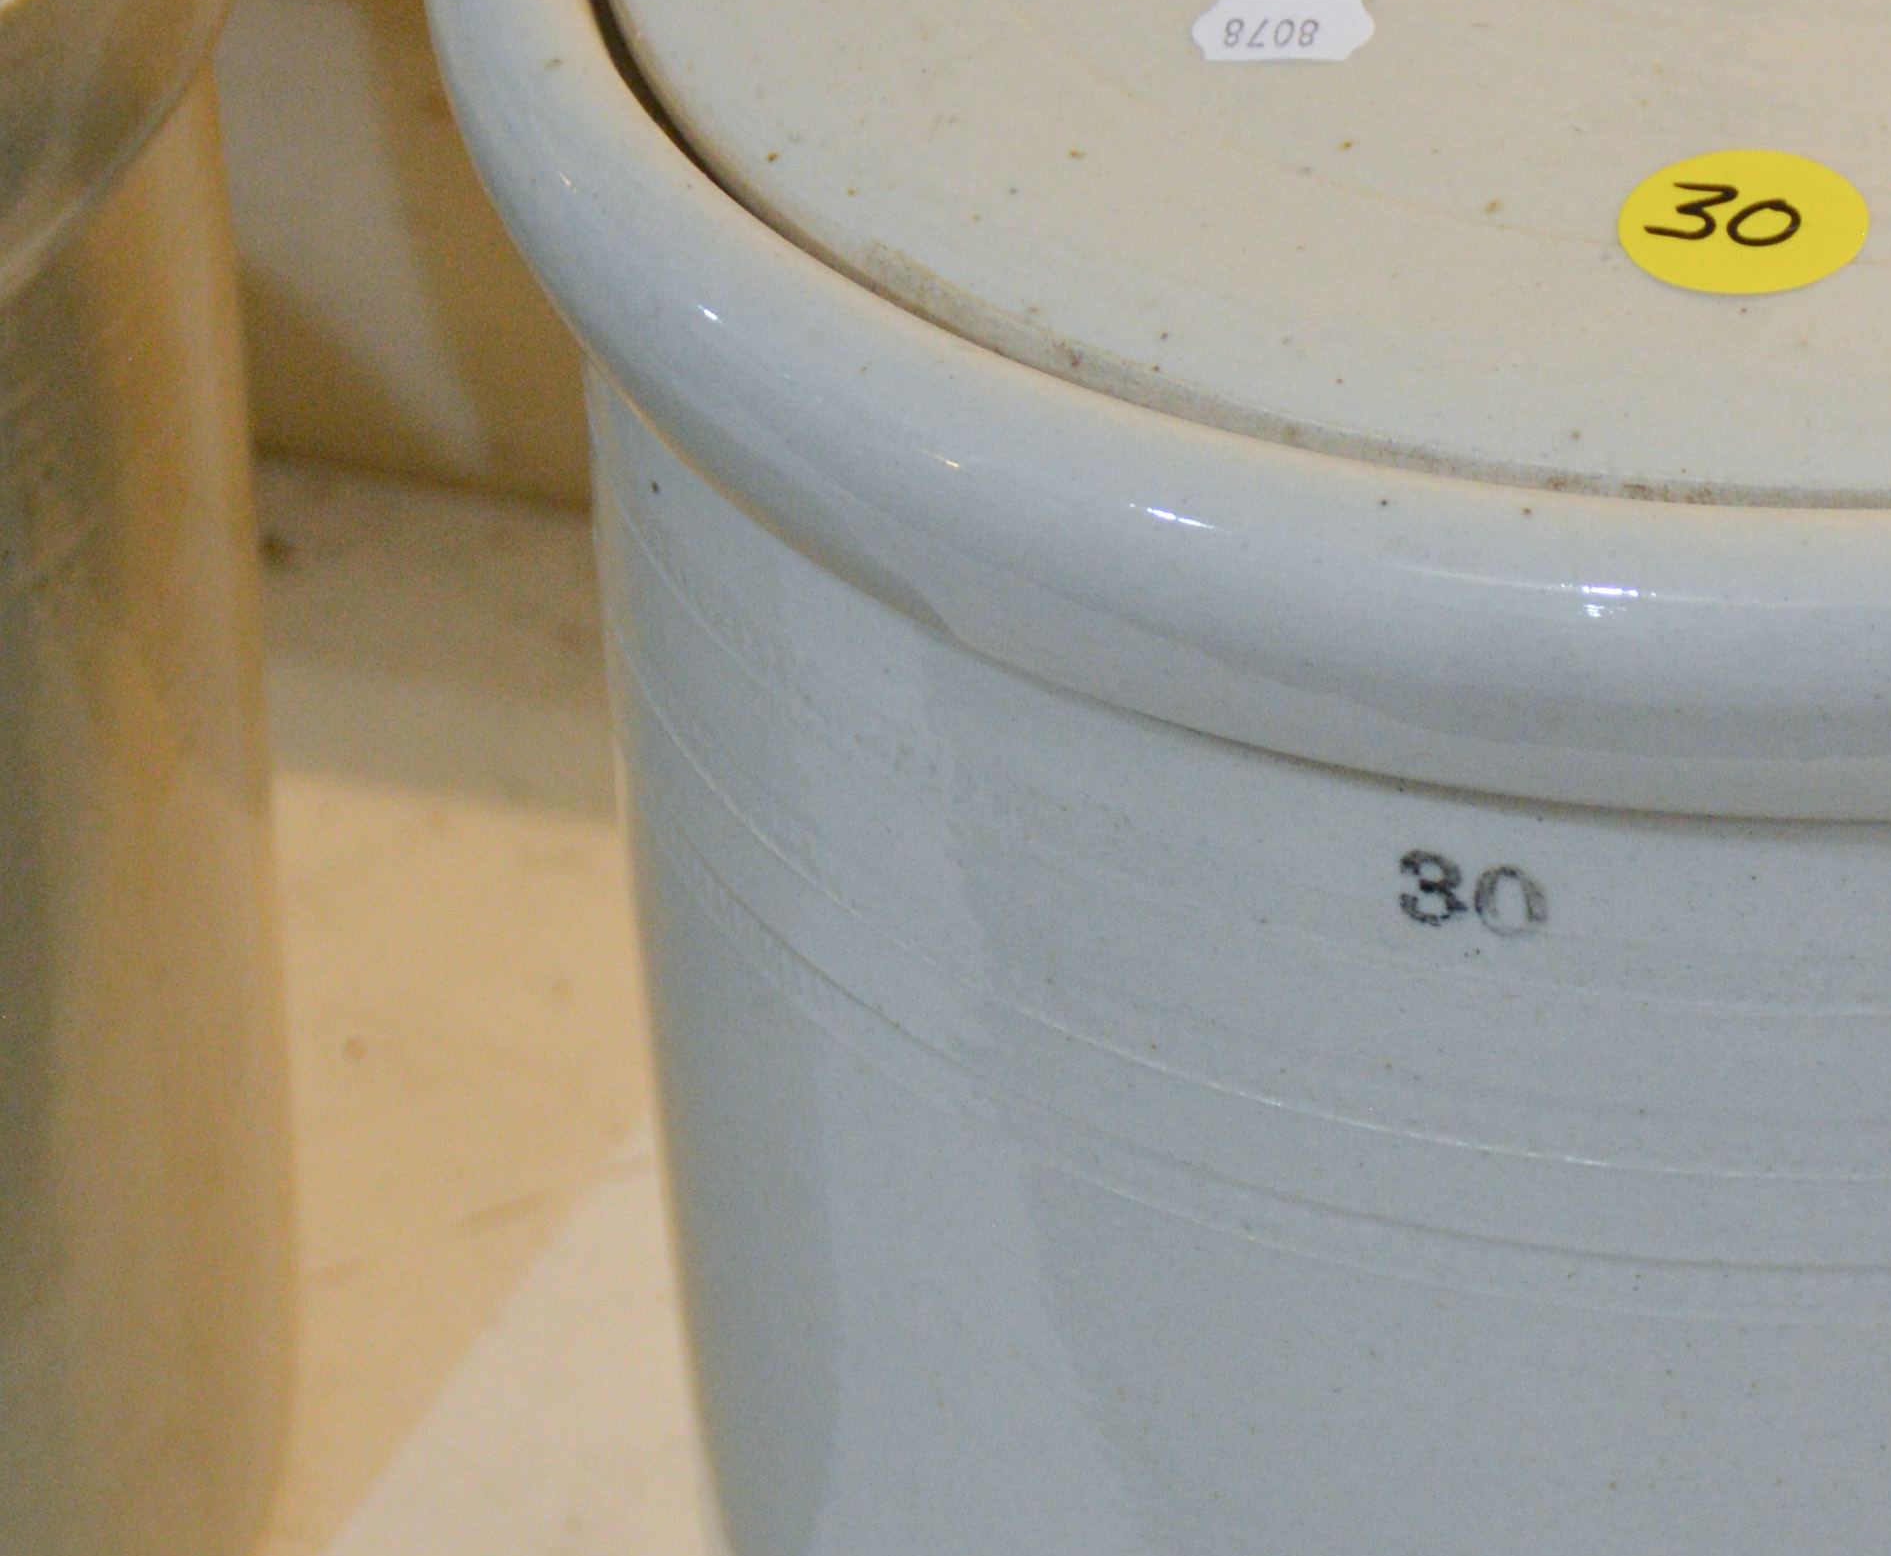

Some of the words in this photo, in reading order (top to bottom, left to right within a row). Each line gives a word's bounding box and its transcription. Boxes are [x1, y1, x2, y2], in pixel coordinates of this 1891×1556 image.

[1223, 18, 1320, 48] 8078
[1643, 181, 1802, 247] 30
[1399, 849, 1549, 938] 30
